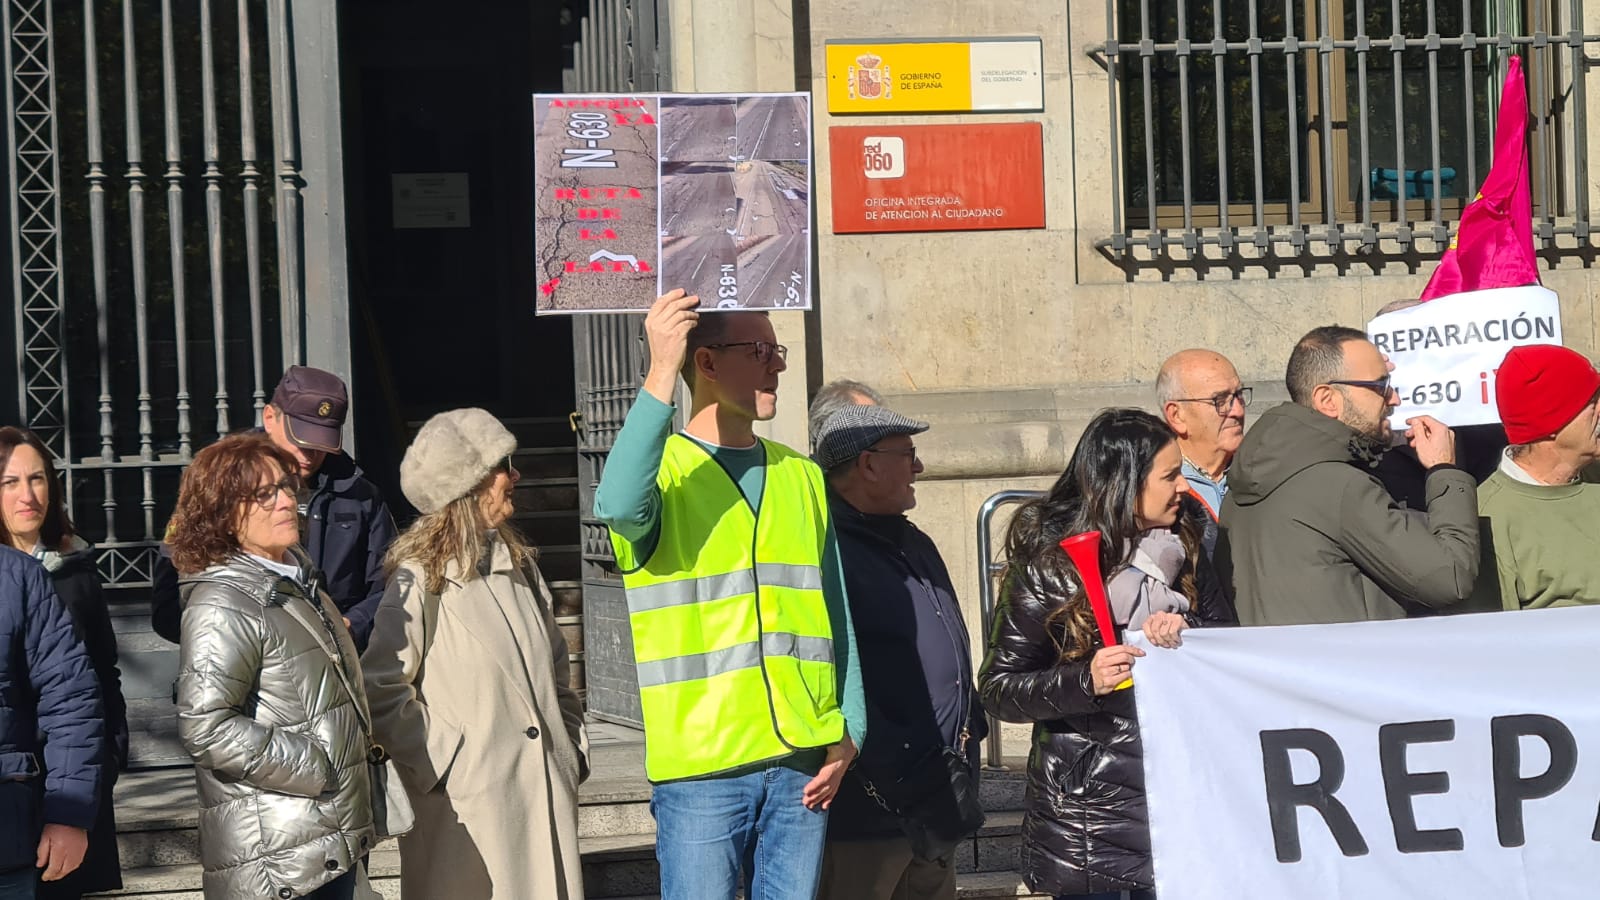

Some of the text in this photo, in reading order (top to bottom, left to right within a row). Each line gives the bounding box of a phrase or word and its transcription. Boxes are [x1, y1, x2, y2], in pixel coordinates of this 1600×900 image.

[900, 72, 942, 80] GOBIERNO
[900, 80, 943, 90] DE ESPAÑA
[612, 113, 656, 125] YA
[560, 111, 618, 169] N-630
[863, 140, 881, 153] red
[865, 152, 893, 171] 060
[555, 187, 643, 200] RUTA
[865, 196, 961, 207] OFICINA INTEGRADA
[577, 207, 622, 220] DE
[865, 210, 878, 220] DE
[931, 209, 943, 219] AL
[945, 208, 1003, 218] CIUDADANO
[578, 228, 618, 240] LA
[563, 260, 653, 272] LATA
[1373, 311, 1555, 354] REPARACIÓN
[1394, 380, 1462, 405] -630
[1258, 713, 1600, 864] REP
